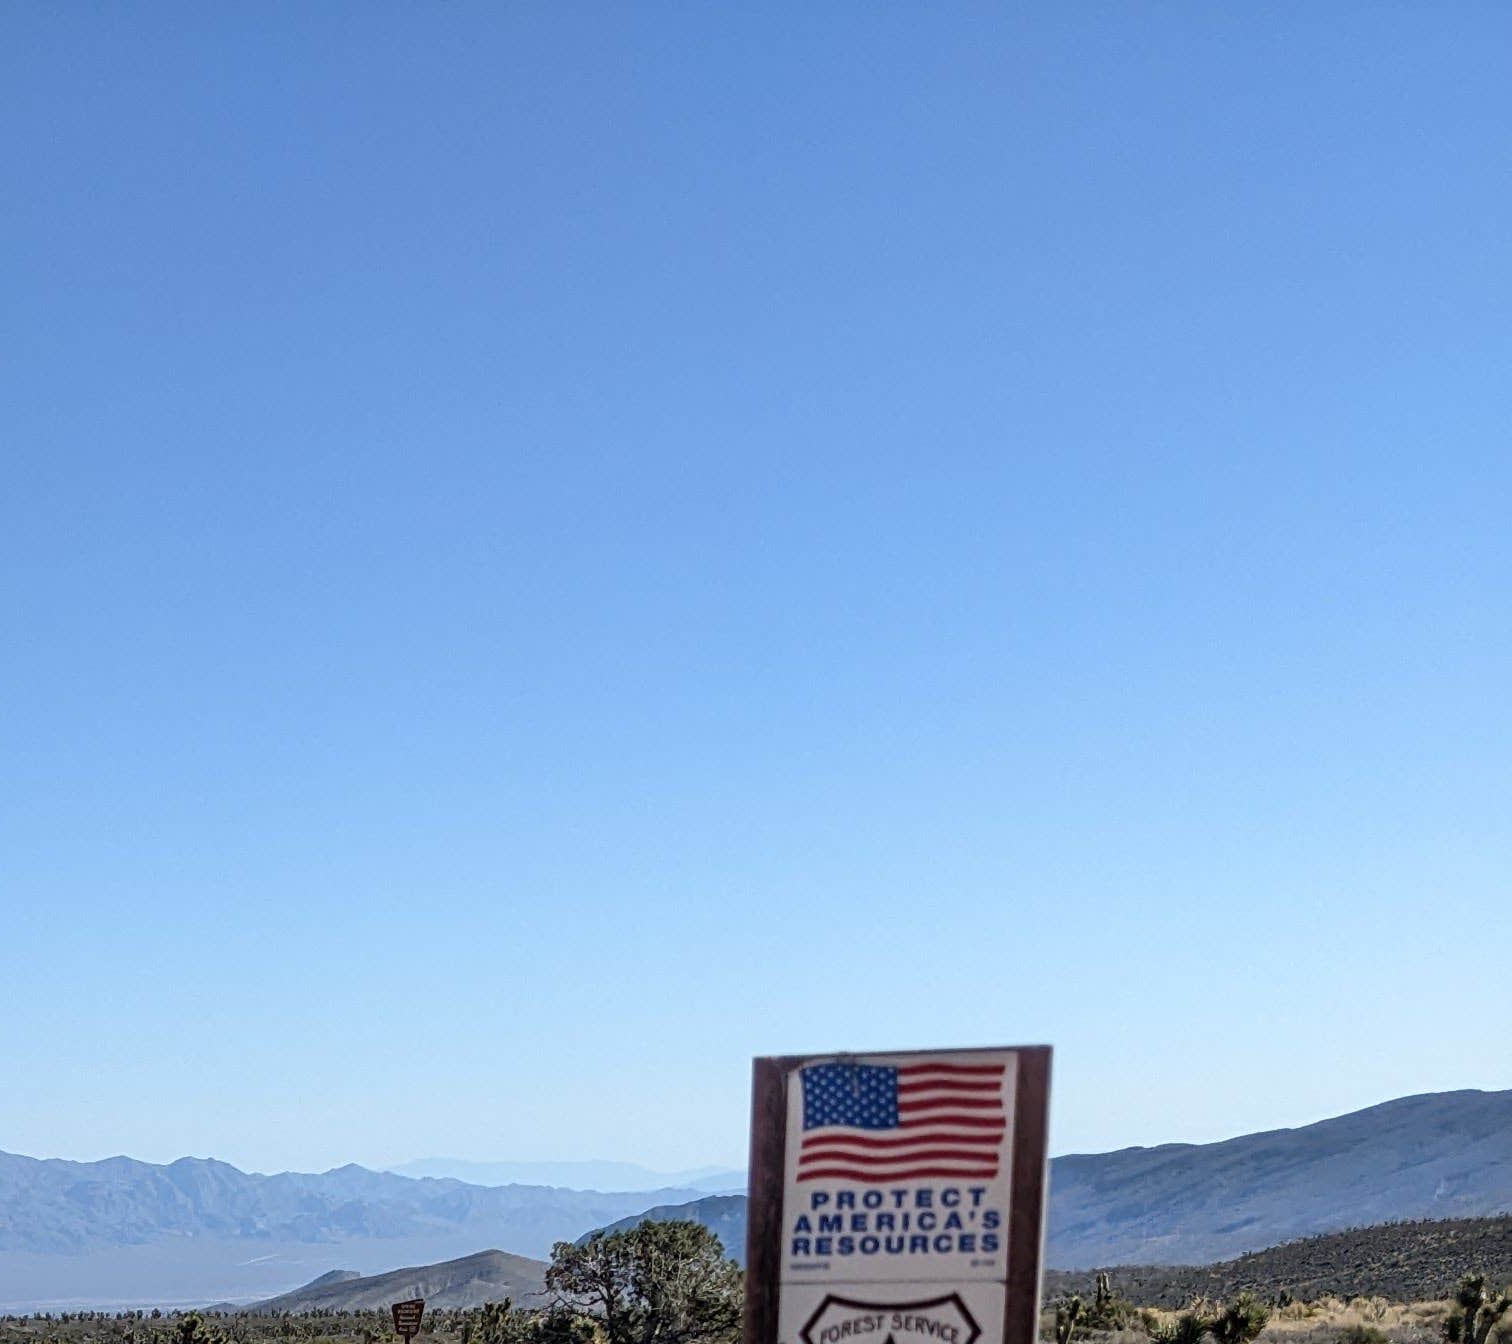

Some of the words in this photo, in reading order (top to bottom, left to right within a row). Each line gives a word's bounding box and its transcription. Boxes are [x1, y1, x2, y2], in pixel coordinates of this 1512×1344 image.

[810, 1187, 987, 1210] PROTECT
[793, 1211, 1001, 1233] AMERICA'S
[790, 1234, 999, 1256] RESOURCES
